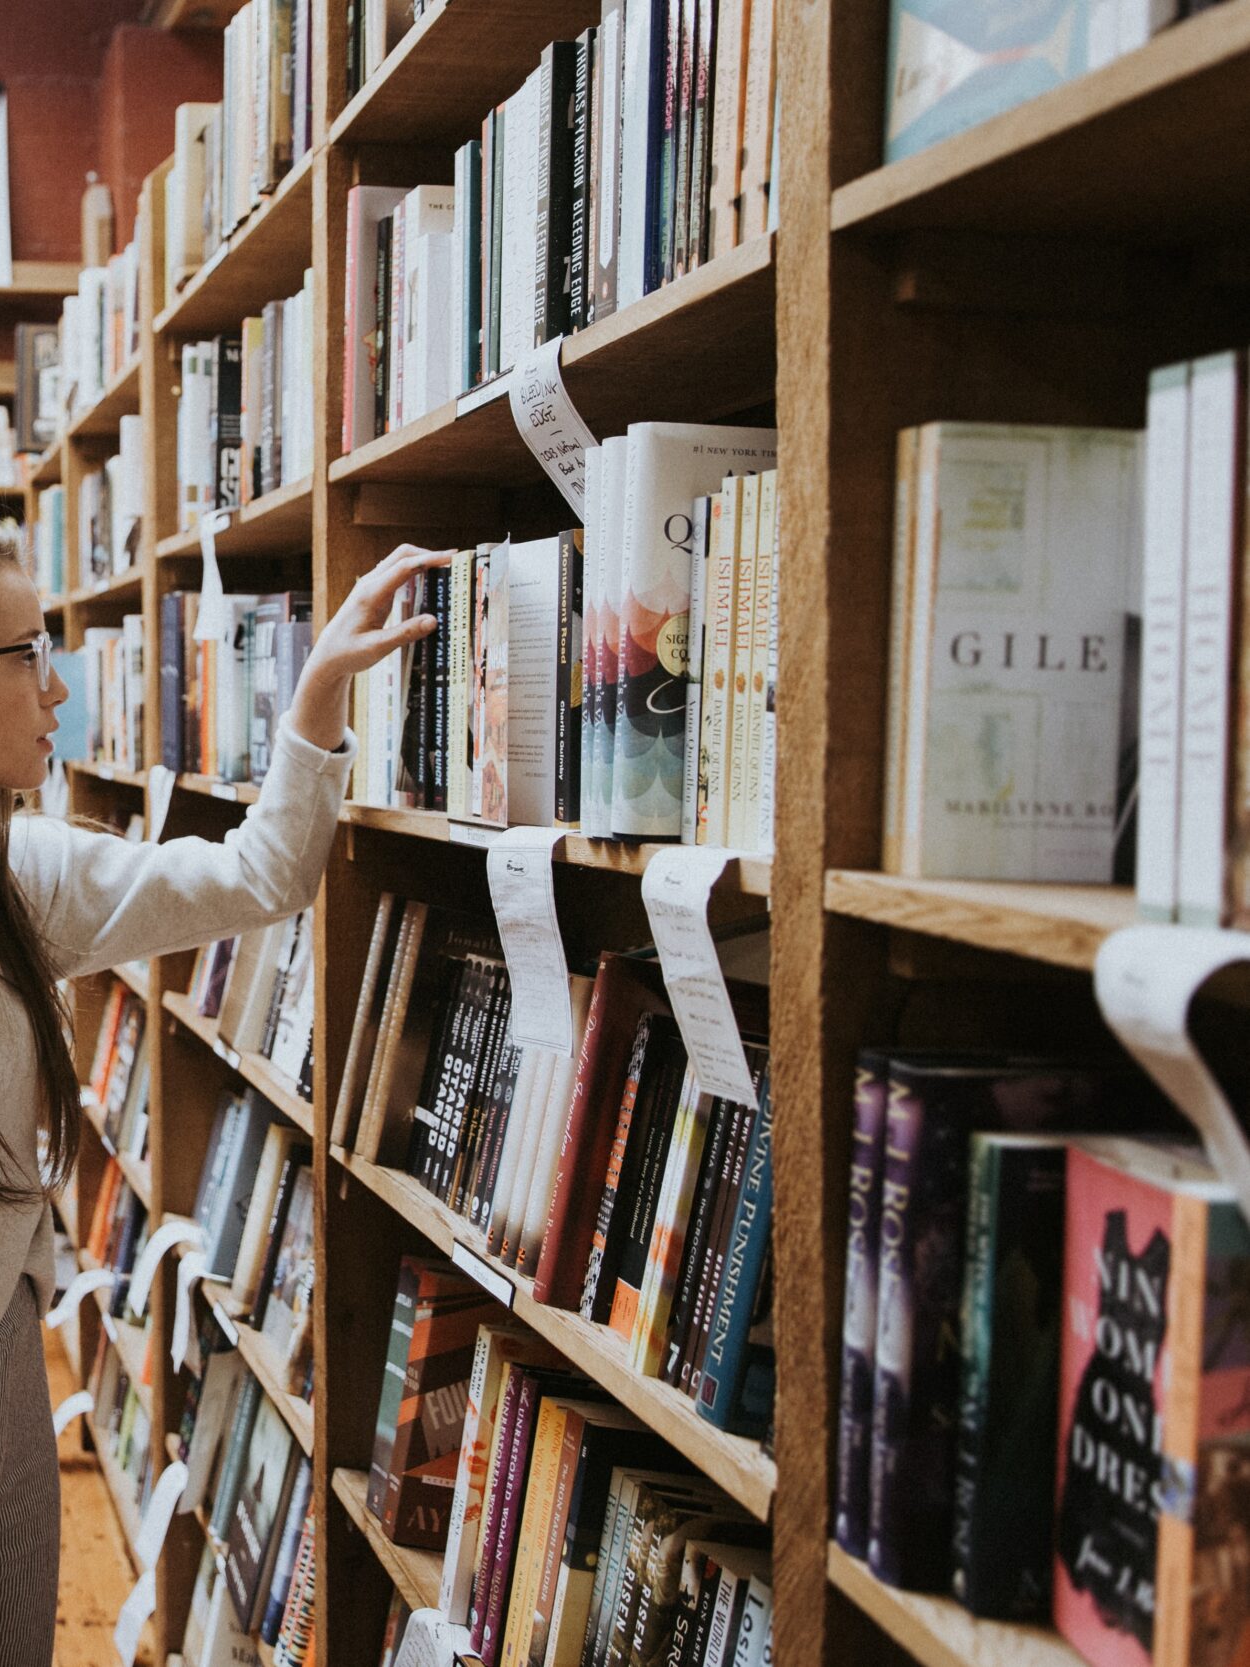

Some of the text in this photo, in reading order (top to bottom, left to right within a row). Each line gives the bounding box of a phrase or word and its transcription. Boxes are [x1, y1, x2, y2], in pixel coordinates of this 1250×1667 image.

[534, 61, 550, 325] THOMAS PYNCHON BLEEDING EDGE
[569, 43, 587, 315] THOMAS PYNCHON BLEEDING EDGE
[707, 446, 727, 456] NEW
[732, 447, 758, 458] YORK
[560, 543, 569, 623] Monument
[752, 553, 772, 655] ISHMAEL
[559, 626, 567, 664] Road
[709, 554, 732, 796] ISHMAEL DANIEL QUINN
[730, 556, 754, 802] ISHMAEL DANIEL QUINN
[434, 686, 442, 746] MATTHEW
[750, 703, 762, 754] DANIEL
[684, 738, 694, 802] Quindlen
[747, 756, 759, 803] QUINN
[477, 996, 501, 1093] THE IMPERFECTIONISTS
[485, 1017, 505, 1097] IMPERFECTIONISTS
[578, 1014, 599, 1061] Devil
[426, 1052, 454, 1147] OTARED
[435, 1056, 463, 1153] OTARED
[445, 1061, 473, 1159] OTARED
[557, 1077, 585, 1158] Jerusalem
[729, 1110, 741, 1137] WHY
[739, 1115, 751, 1142] WHY
[640, 1157, 649, 1178] Story
[650, 1162, 659, 1183] Story
[719, 1149, 733, 1180] CAME
[730, 1154, 743, 1186] CAME
[629, 1195, 642, 1238] Childhood
[638, 1201, 651, 1244] Childhood
[679, 1122, 723, 1302] RAKHA the CROCODILES
[707, 1198, 757, 1367] PUNISHMENT
[473, 1367, 484, 1398] RAND
[489, 1394, 512, 1488] UNRESTORED
[536, 1406, 551, 1442] KNOW
[549, 1421, 564, 1456] KNOW
[531, 1446, 545, 1478] YOUR
[544, 1461, 558, 1495] YOUR
[480, 1492, 497, 1548] WOMAN
[488, 1407, 525, 1618] UNRESTORED WOMAN SHOBHA
[554, 1482, 566, 1511] RON
[548, 1512, 561, 1547] RASH
[539, 1548, 555, 1602] READER
[615, 1516, 645, 1633] THE RISEN
[633, 1533, 661, 1651] THE RISEN
[692, 1591, 710, 1663] RON RASH
[708, 1579, 733, 1667] THE WORLD
